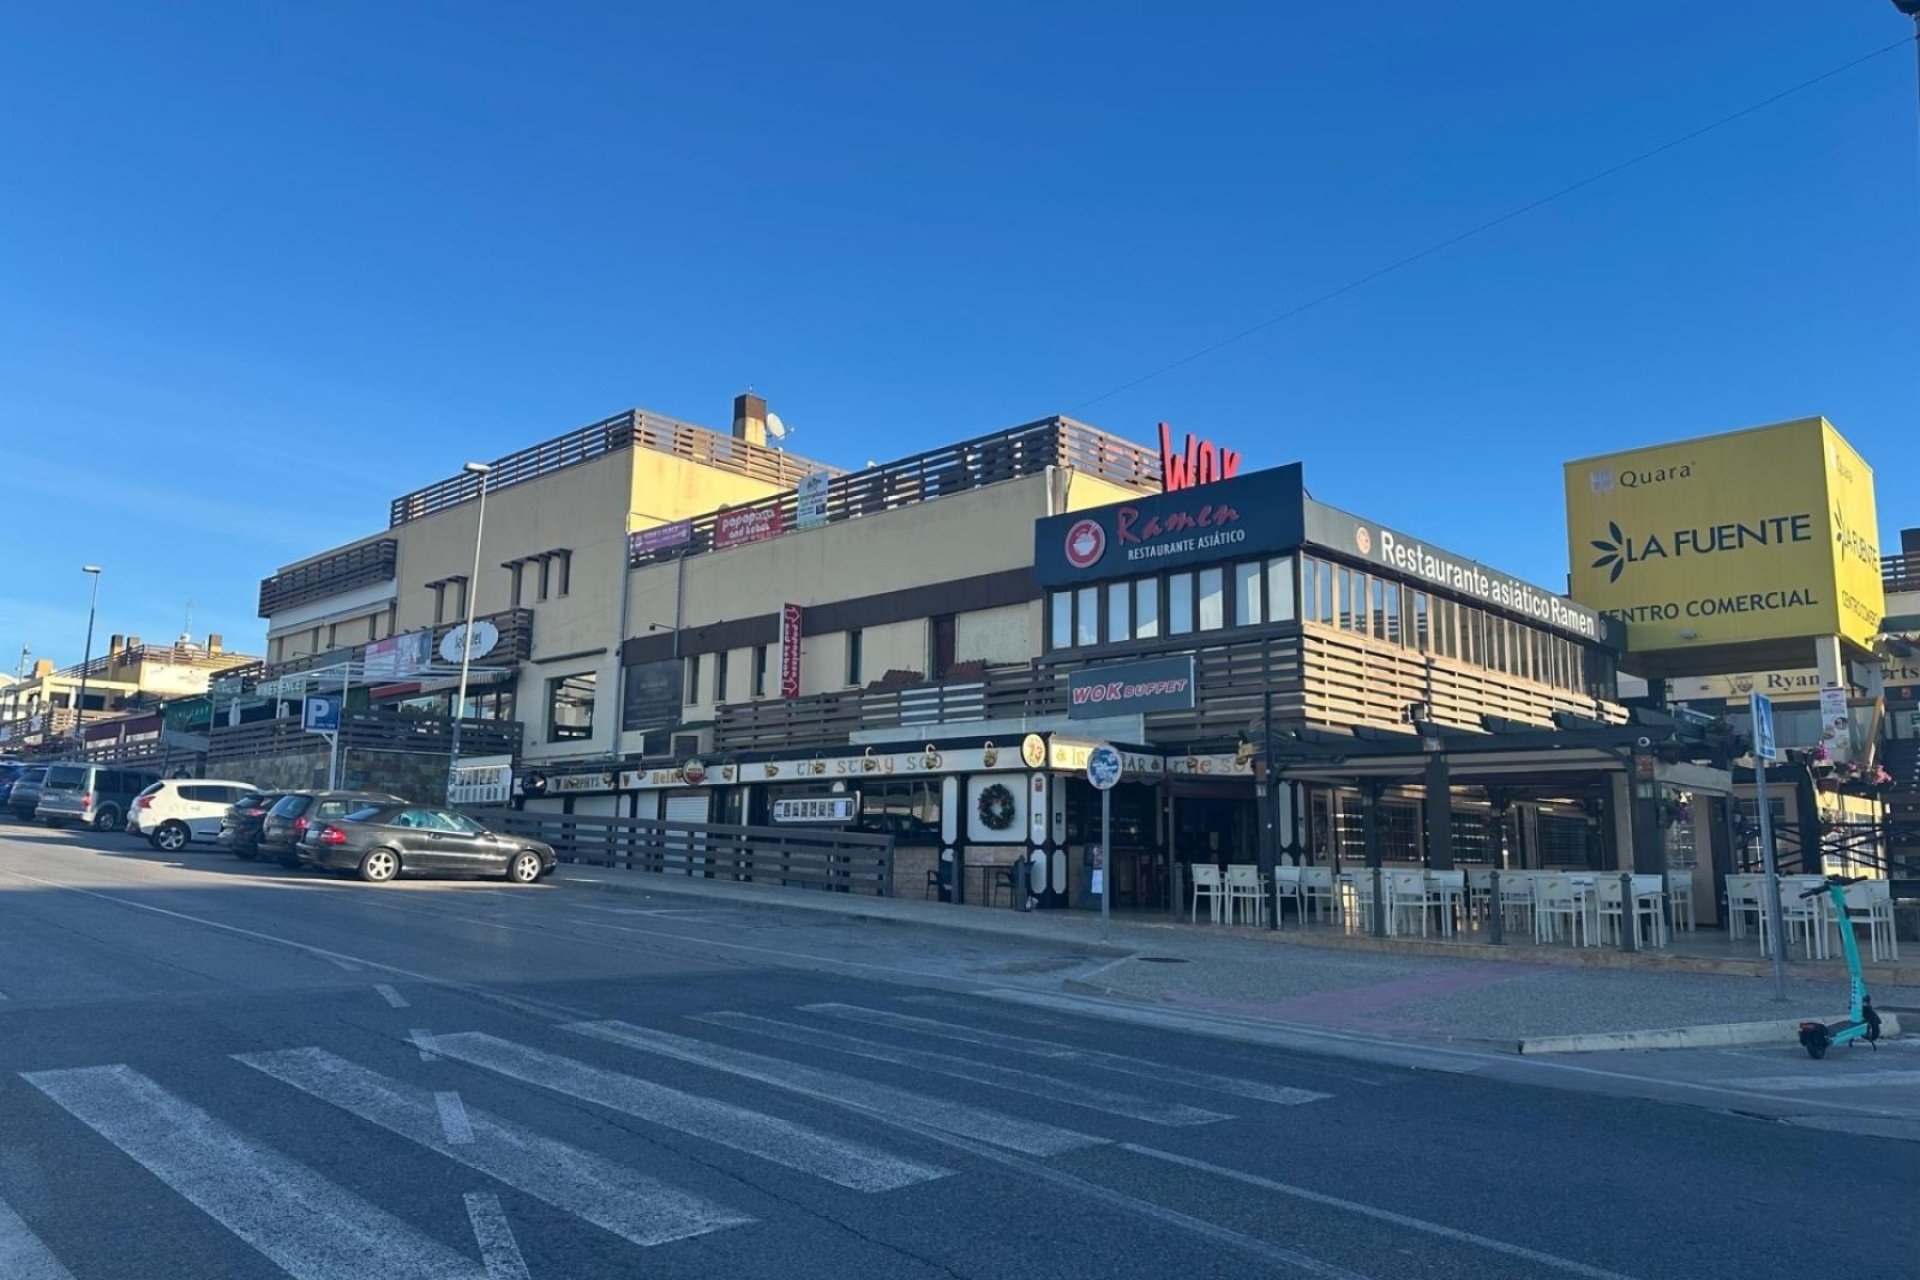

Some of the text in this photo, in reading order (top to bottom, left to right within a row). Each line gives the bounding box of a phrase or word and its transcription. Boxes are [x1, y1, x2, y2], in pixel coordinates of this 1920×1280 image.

[1620, 464, 1691, 488] Quara
[1116, 504, 1241, 546] Ramen
[1626, 514, 1811, 563] LA FUENTE
[1128, 528, 1245, 561] RESTAURANTE ASIÁTICO
[1380, 530, 1595, 636] Restaurante asiático Ramen
[1599, 588, 1818, 622] ENTRO COMERCIAL
[1073, 678, 1188, 704] WOK BUFFET
[306, 698, 330, 727] P
